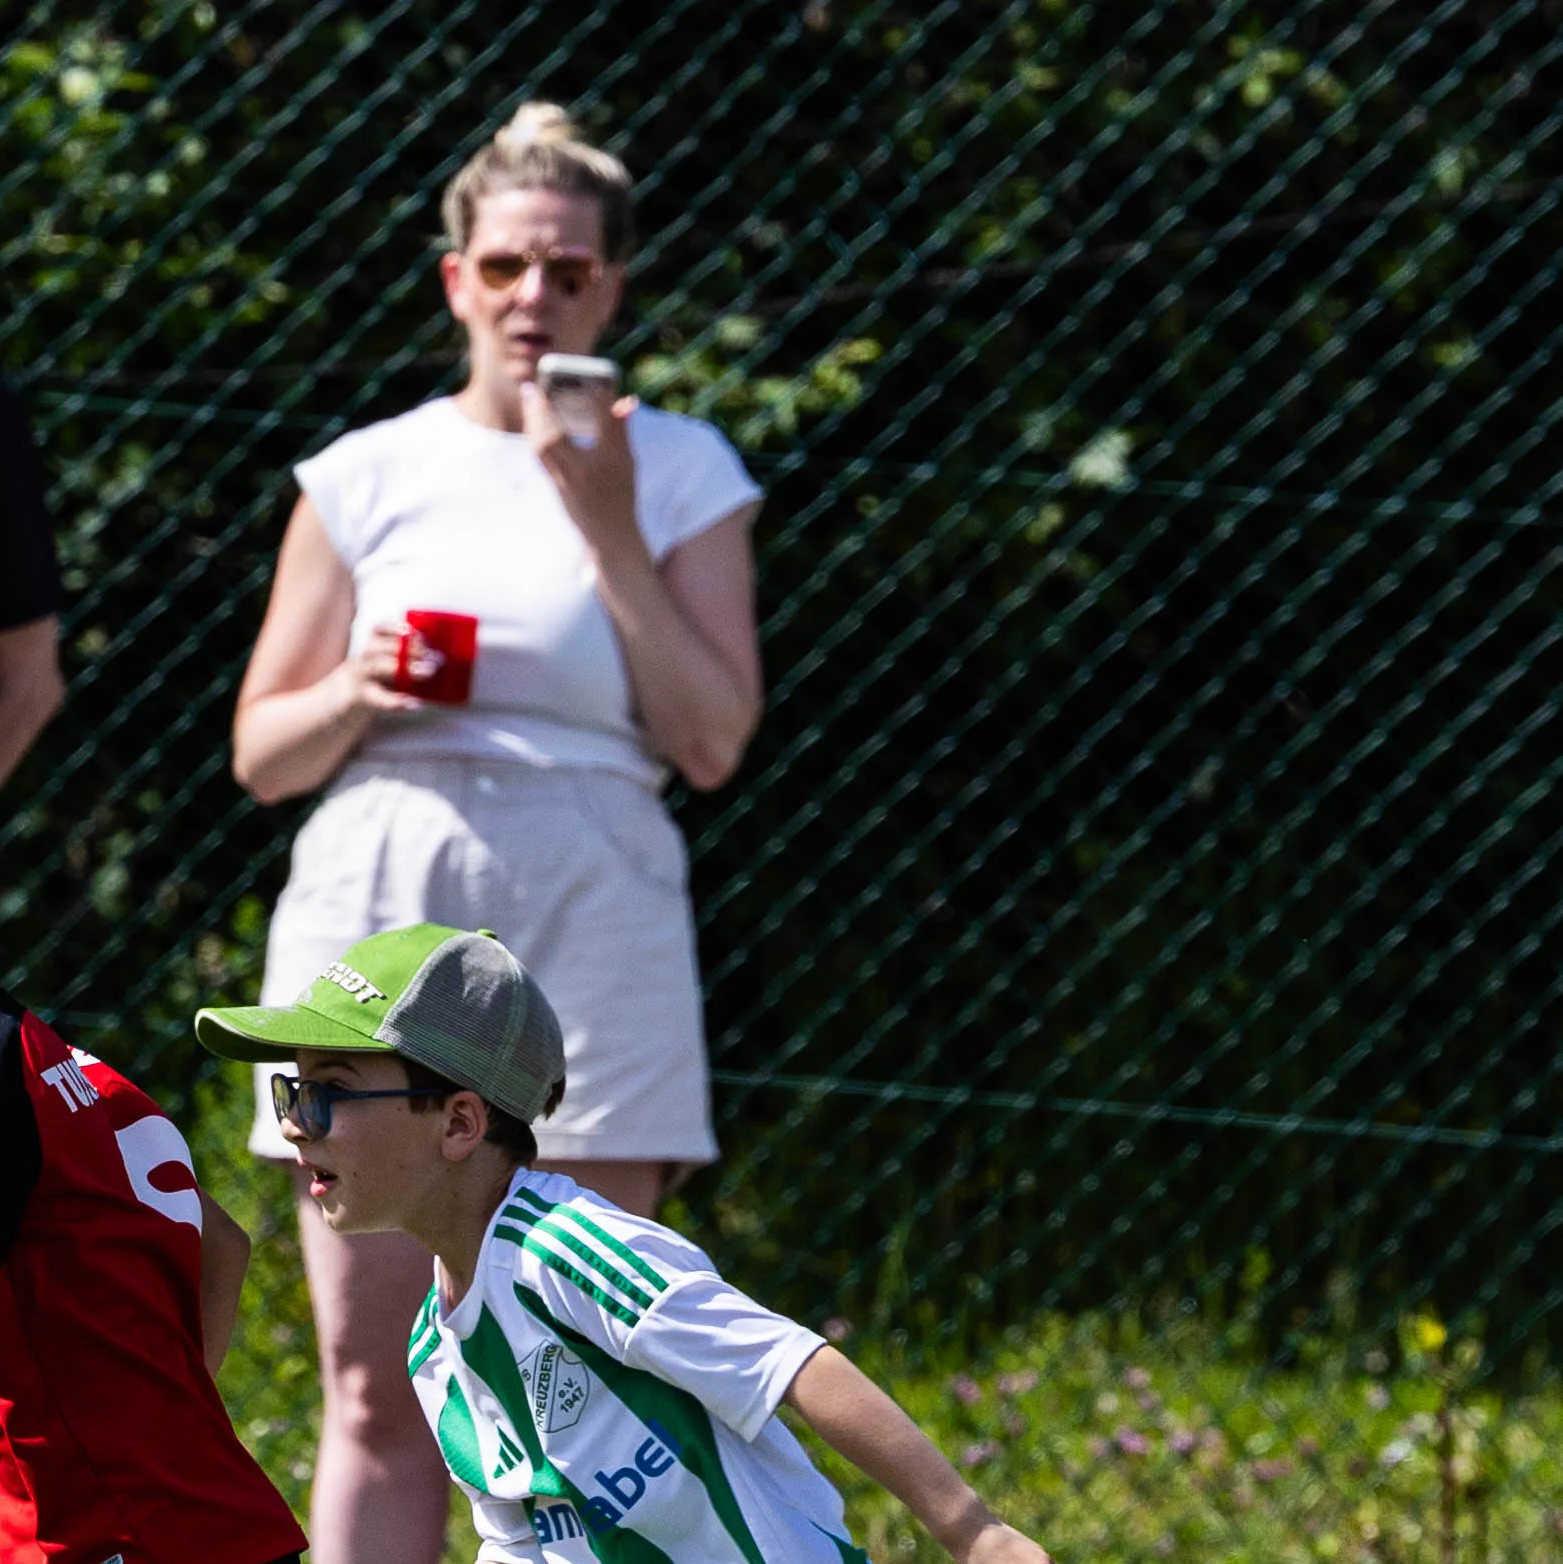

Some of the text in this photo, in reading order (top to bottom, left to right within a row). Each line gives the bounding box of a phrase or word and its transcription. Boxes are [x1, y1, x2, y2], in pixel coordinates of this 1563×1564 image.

[316, 961, 387, 1004] ENDT
[535, 1344, 557, 1428] KREUZBERG
[558, 1377, 578, 1398] e.V.
[560, 1386, 585, 1413] 1947
